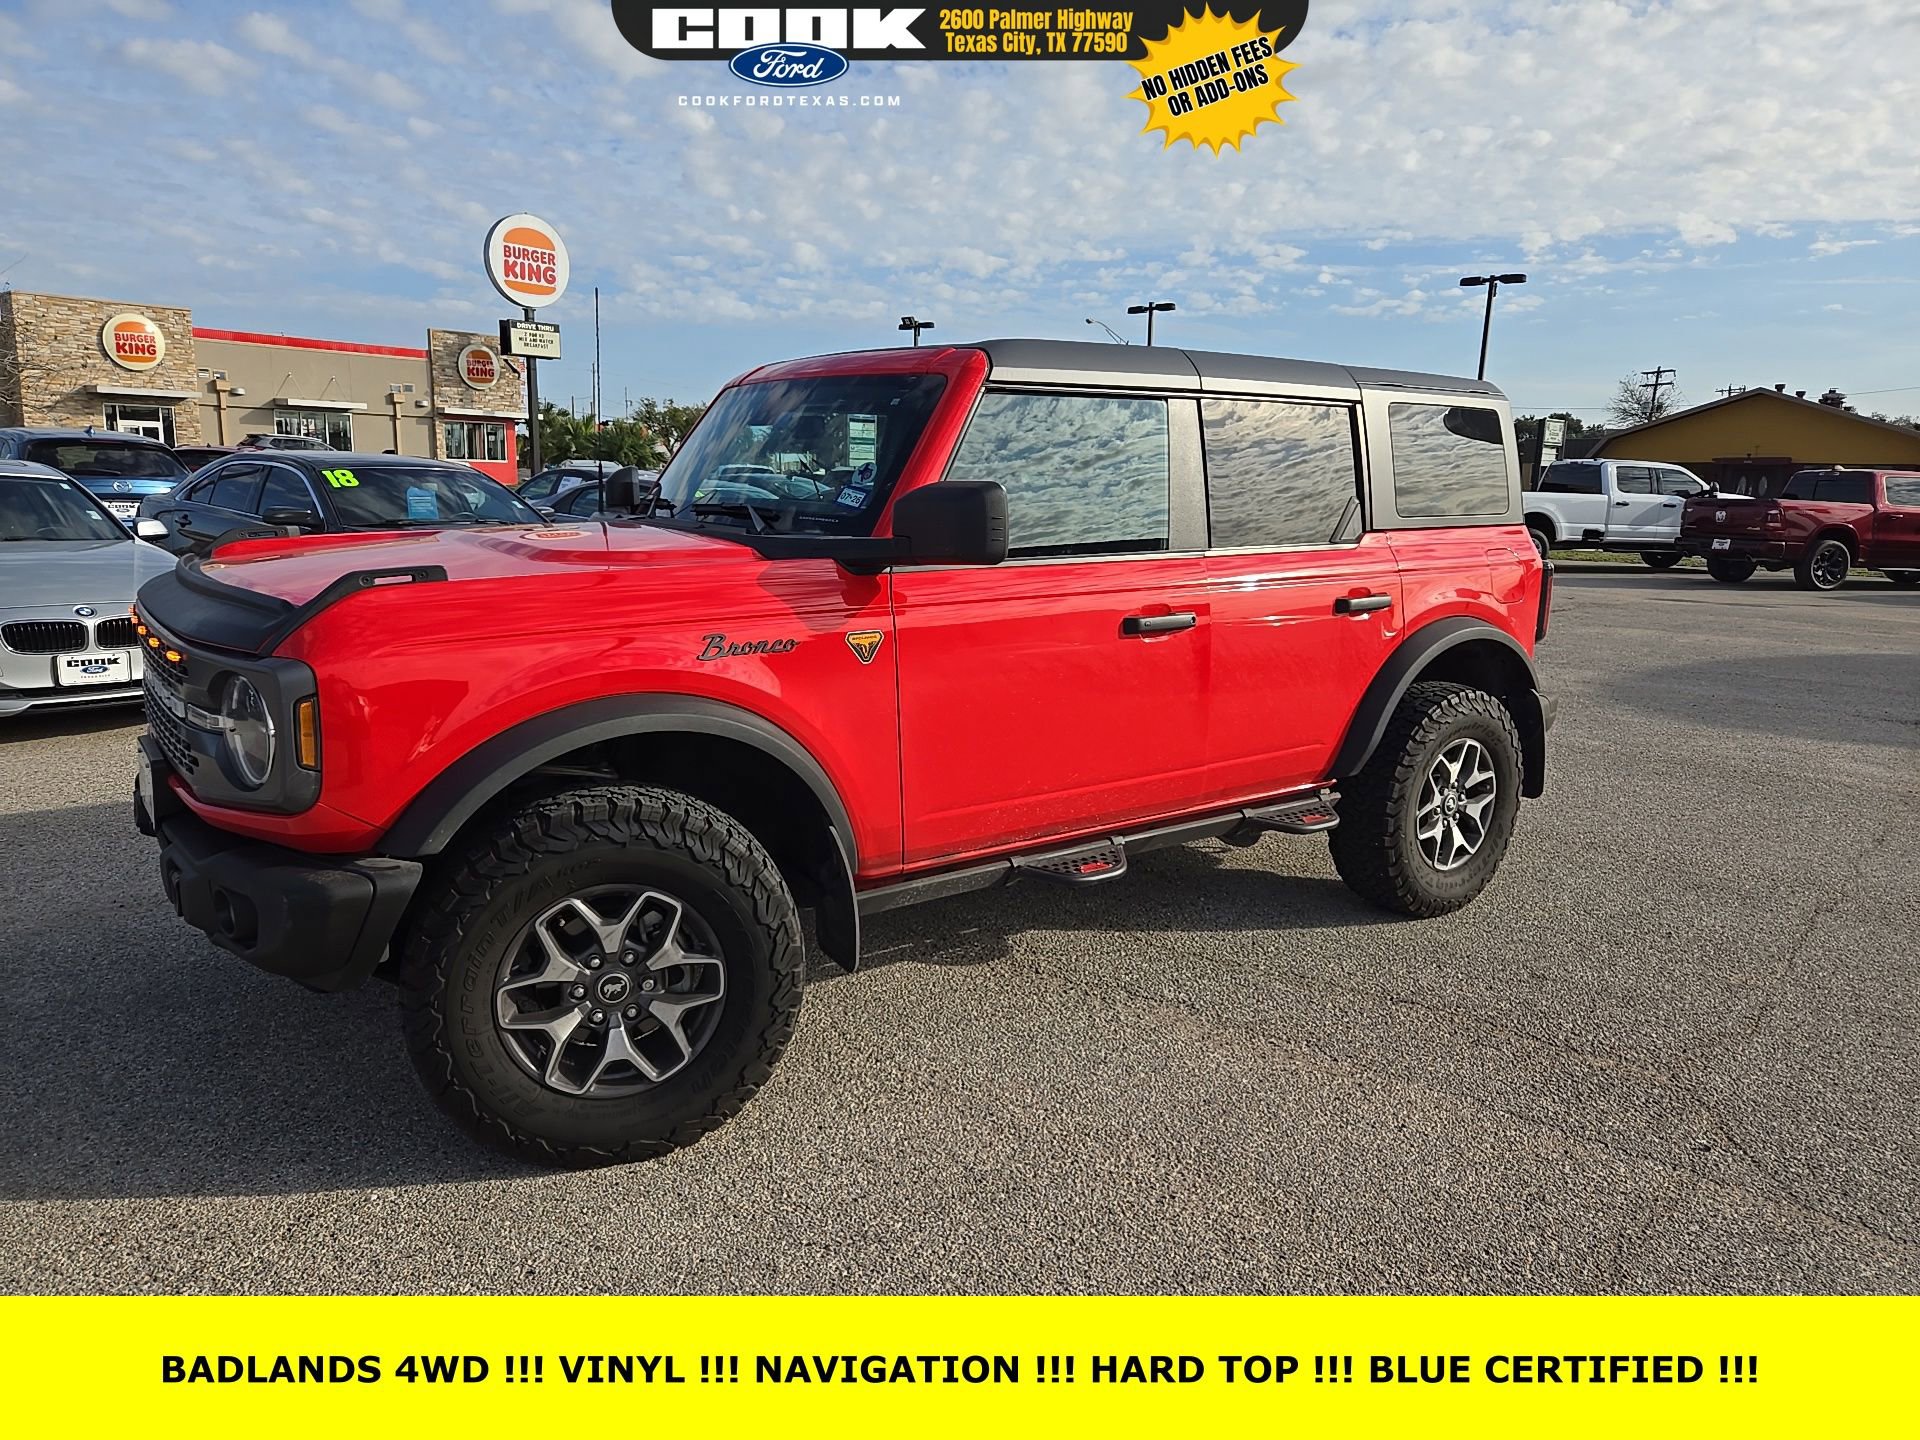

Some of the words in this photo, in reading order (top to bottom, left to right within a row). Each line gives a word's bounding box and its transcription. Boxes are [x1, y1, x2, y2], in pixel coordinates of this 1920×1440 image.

[503, 244, 556, 266] BURGER
[503, 258, 557, 285] KING
[516, 322, 537, 330] DRIVE
[537, 324, 555, 332] THRU
[114, 332, 156, 344] BURGER
[115, 341, 157, 356] KING
[466, 359, 494, 368] BURGER
[466, 366, 495, 378] KING
[322, 469, 360, 488] 18
[696, 633, 799, 661] Bronco
[66, 657, 121, 668] COOK
